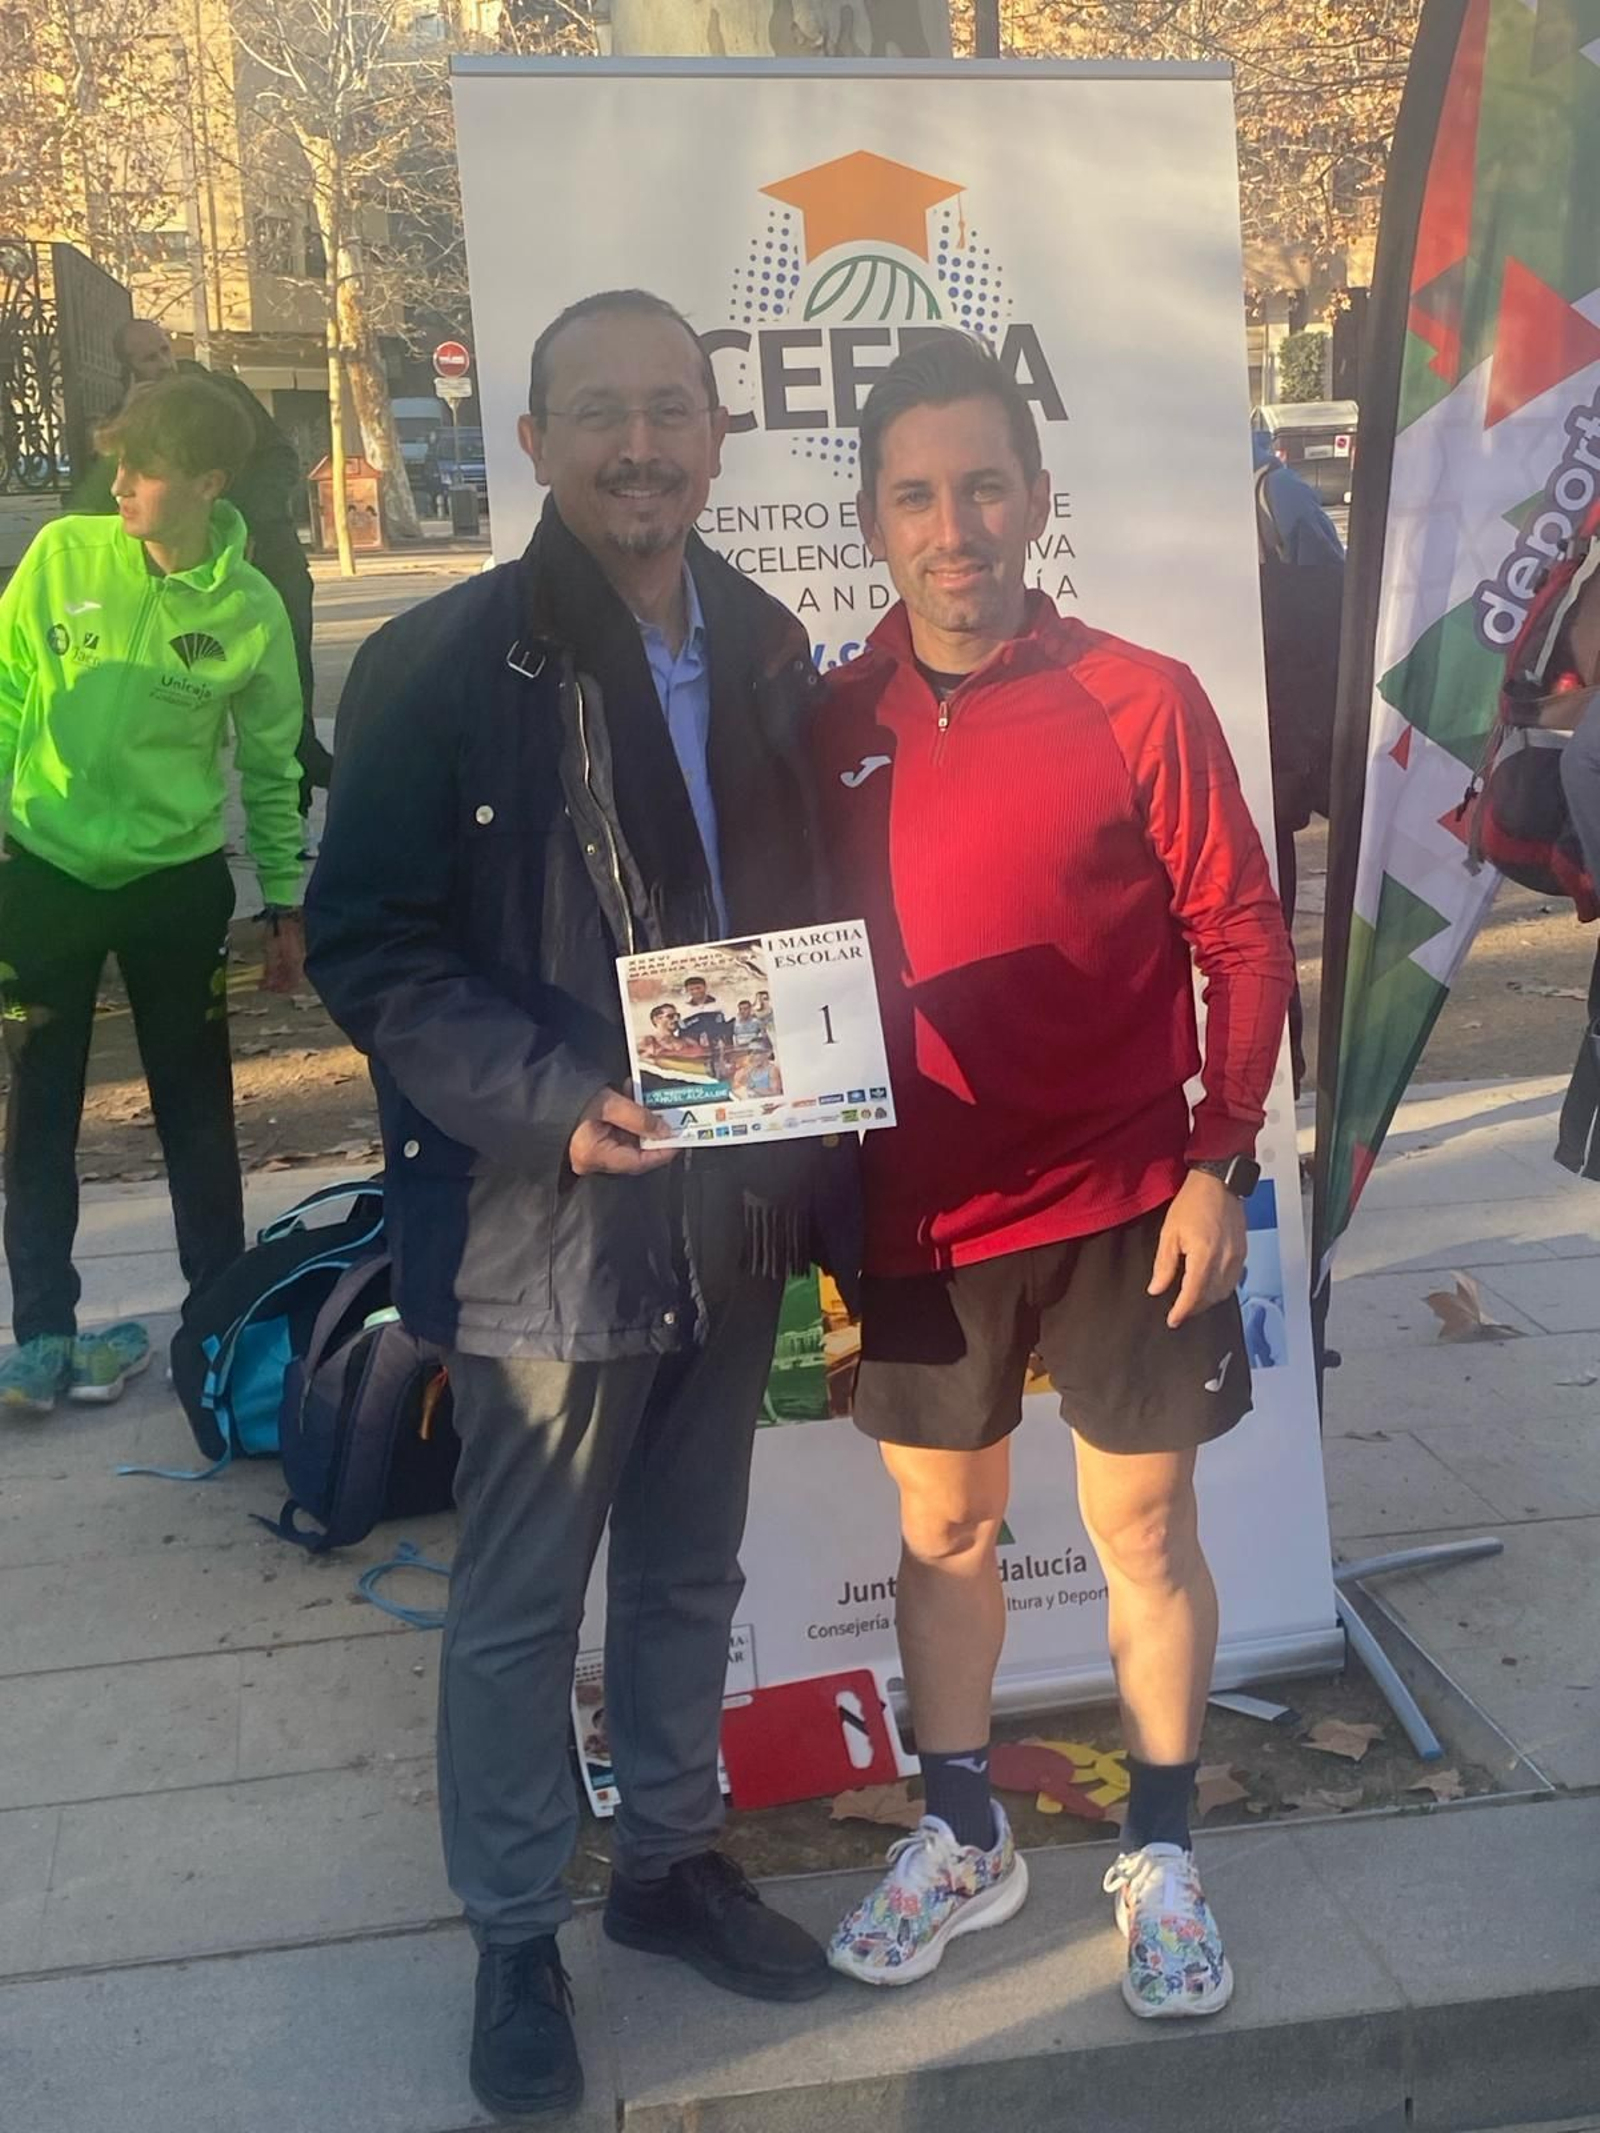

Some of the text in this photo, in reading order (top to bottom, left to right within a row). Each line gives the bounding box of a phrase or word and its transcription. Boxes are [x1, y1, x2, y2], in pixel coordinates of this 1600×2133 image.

[697, 324, 1069, 433] CEEA
[696, 502, 829, 533] CENTRO
[775, 945, 863, 969] ESCOLAR
[778, 928, 863, 950] MARCHA
[819, 1004, 840, 1045] 1
[837, 1547, 1087, 1605] Junt dalucía
[807, 1586, 1108, 1640] Consejería ltura y Deport
